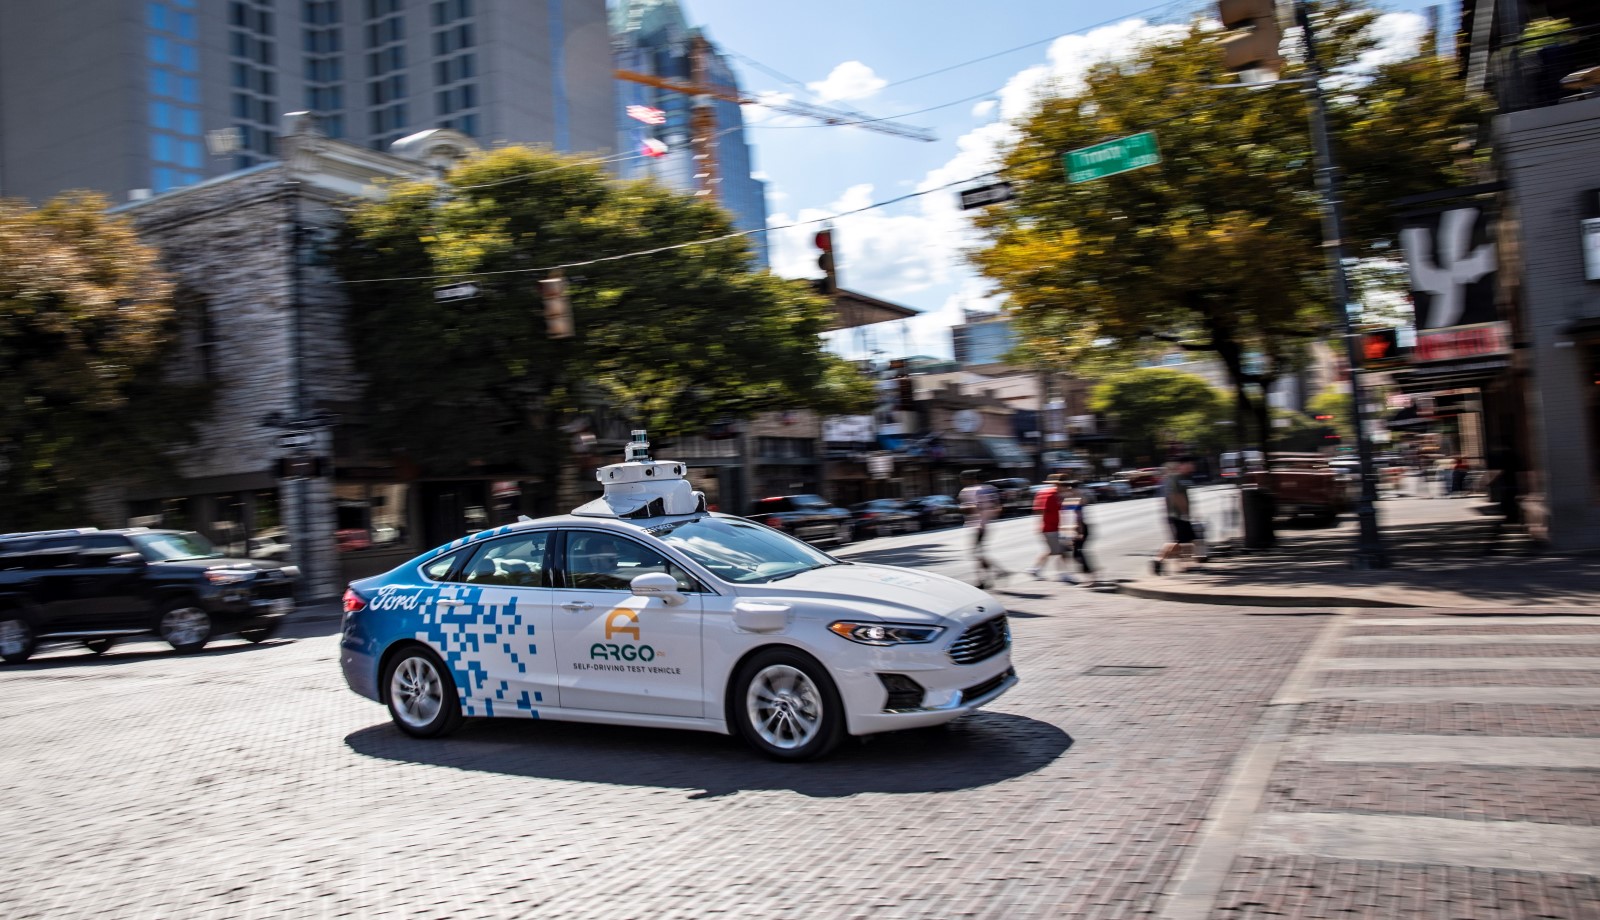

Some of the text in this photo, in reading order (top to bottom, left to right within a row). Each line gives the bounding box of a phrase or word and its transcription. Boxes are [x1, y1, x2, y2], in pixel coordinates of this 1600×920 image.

[369, 584, 423, 611] Ford
[590, 643, 655, 662] ARGO
[573, 663, 625, 672] SELF-DRIVING
[648, 667, 681, 675] VEHICLE
